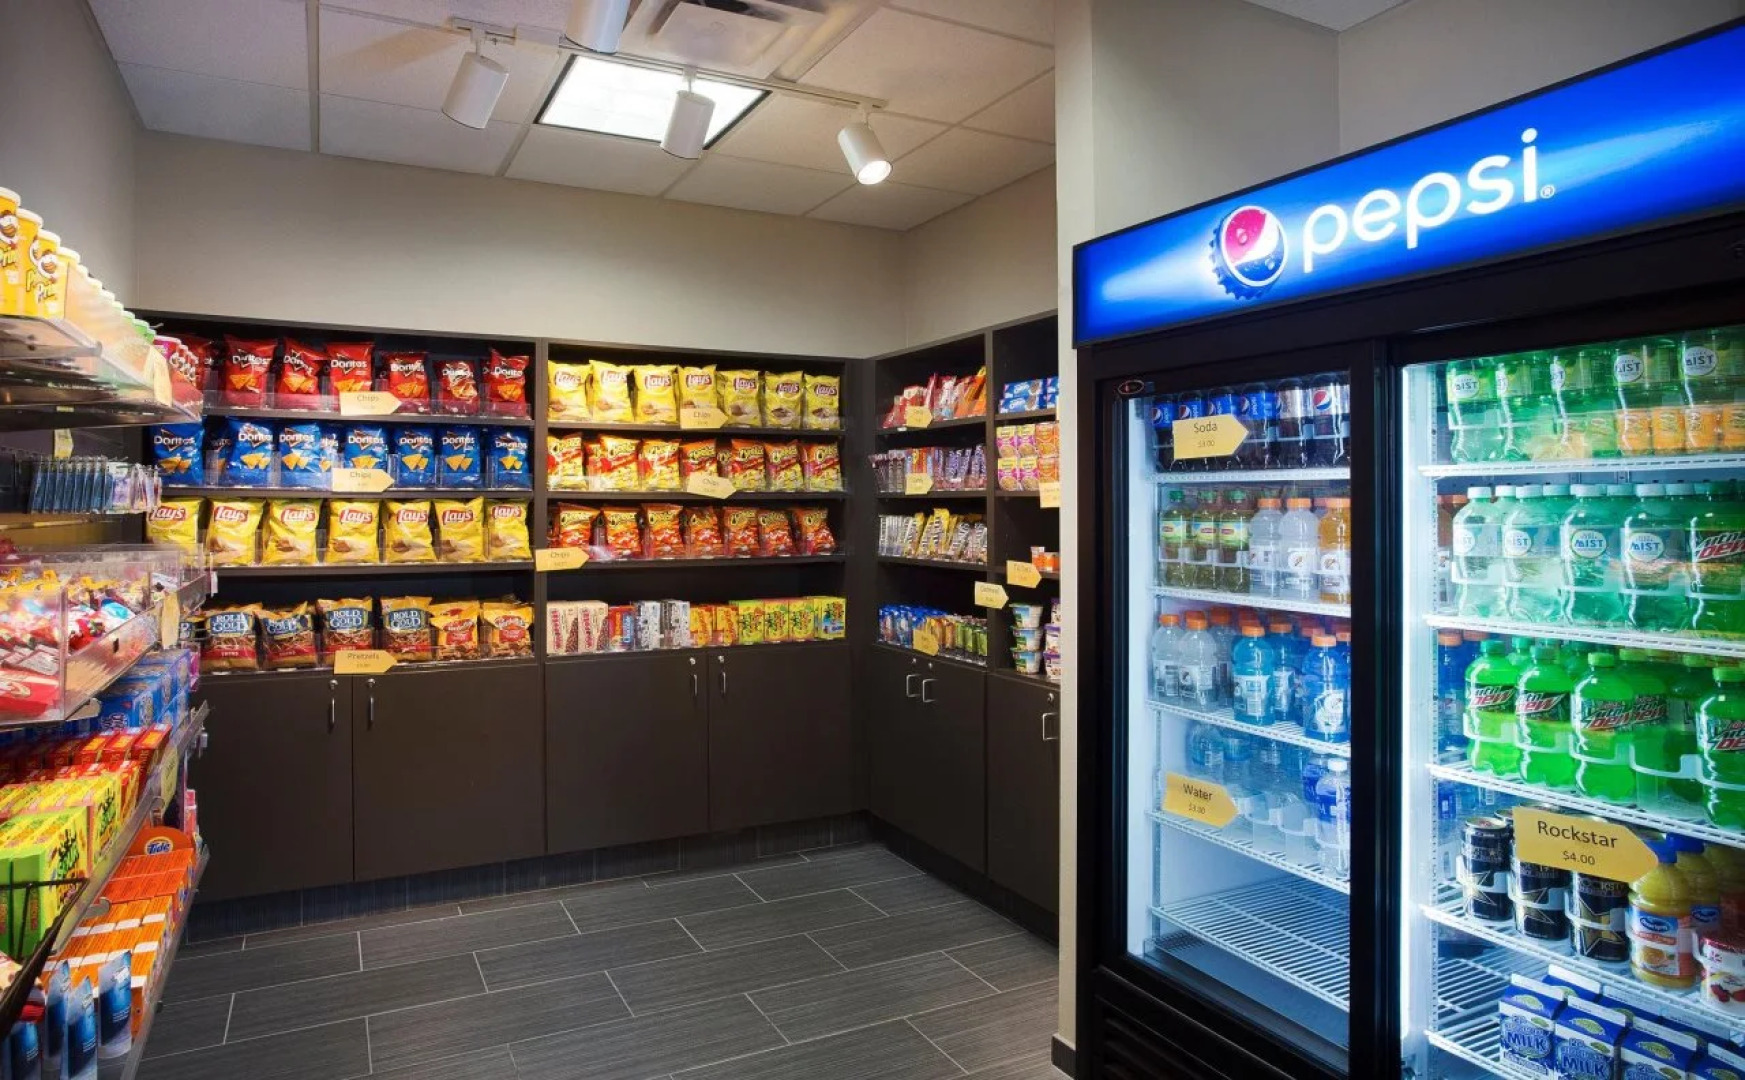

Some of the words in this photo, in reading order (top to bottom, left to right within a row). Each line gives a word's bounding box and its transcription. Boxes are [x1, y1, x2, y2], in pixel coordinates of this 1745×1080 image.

[1302, 128, 1538, 273] pepsi
[331, 359, 367, 369] Doritos
[1193, 422, 1218, 434] Soda
[154, 435, 195, 446] Doritos
[348, 436, 384, 445] Doritos
[1574, 538, 1604, 549] MIST
[333, 609, 362, 618] ROLD
[393, 610, 419, 619] ROLD
[330, 615, 363, 628] GOLD
[391, 617, 421, 629] GOLD
[347, 652, 379, 661] Pretzels
[1182, 782, 1213, 802] Water
[1537, 820, 1619, 849] Rockstar
[147, 841, 171, 855] Tide
[1563, 850, 1596, 867] $4.00
[1507, 1031, 1545, 1051] MILK
[1563, 1056, 1605, 1077] MILK
